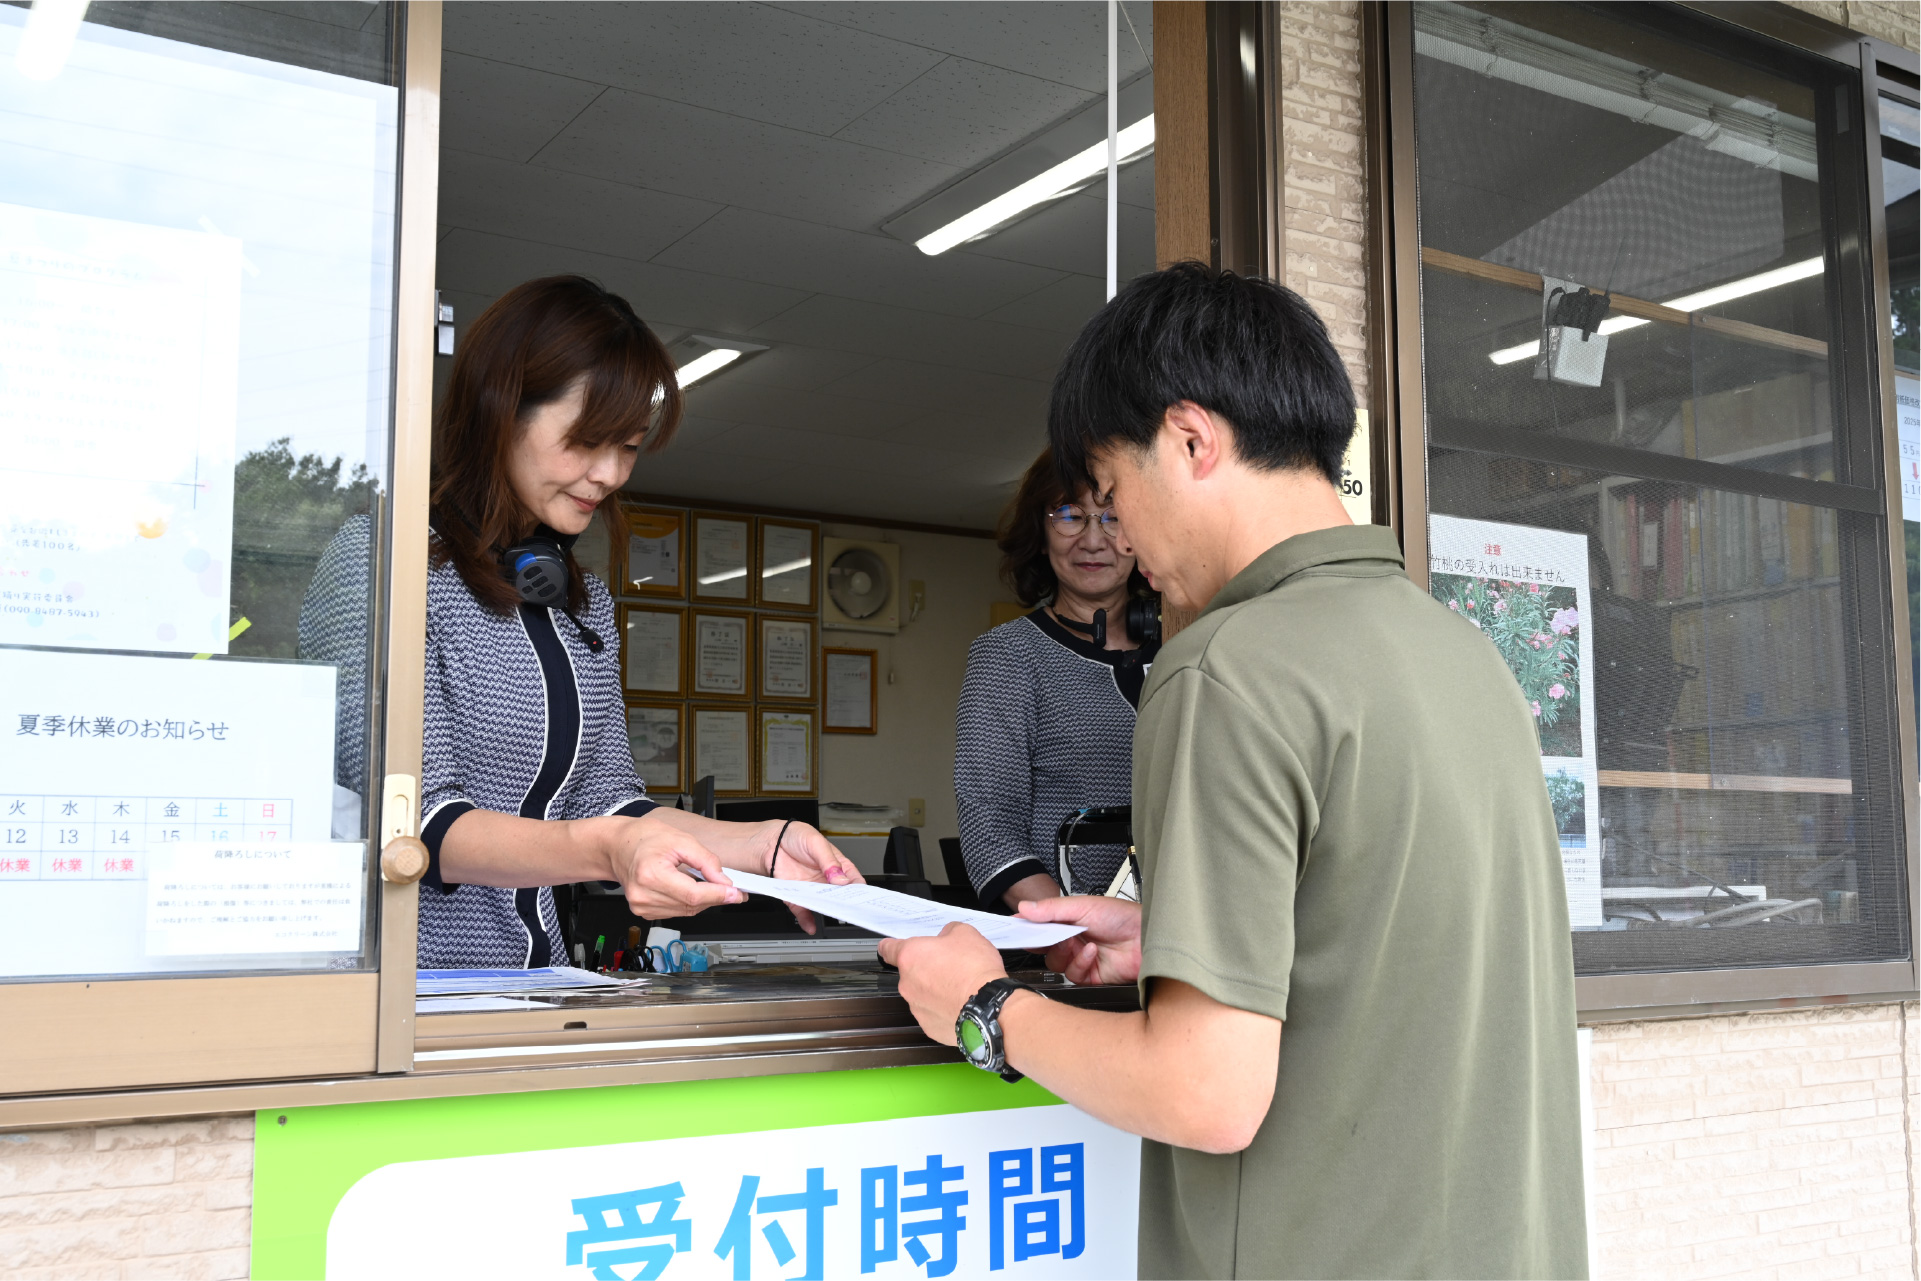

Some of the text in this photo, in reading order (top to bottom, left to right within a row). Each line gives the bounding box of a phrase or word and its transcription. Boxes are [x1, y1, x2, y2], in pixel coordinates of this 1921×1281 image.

[1904, 483, 1920, 495] 11
[1484, 543, 1502, 556] 注意
[16, 713, 229, 741] 夏季休業のお知らせ
[8, 800, 274, 818] 火 水 木 金 土 日
[6, 828, 277, 844] 12 13 14 15 16 17
[214, 850, 292, 859] 荷降ろしについて
[0, 857, 134, 873] 休業 休業 休業
[566, 1142, 1086, 1281] 受付時間
